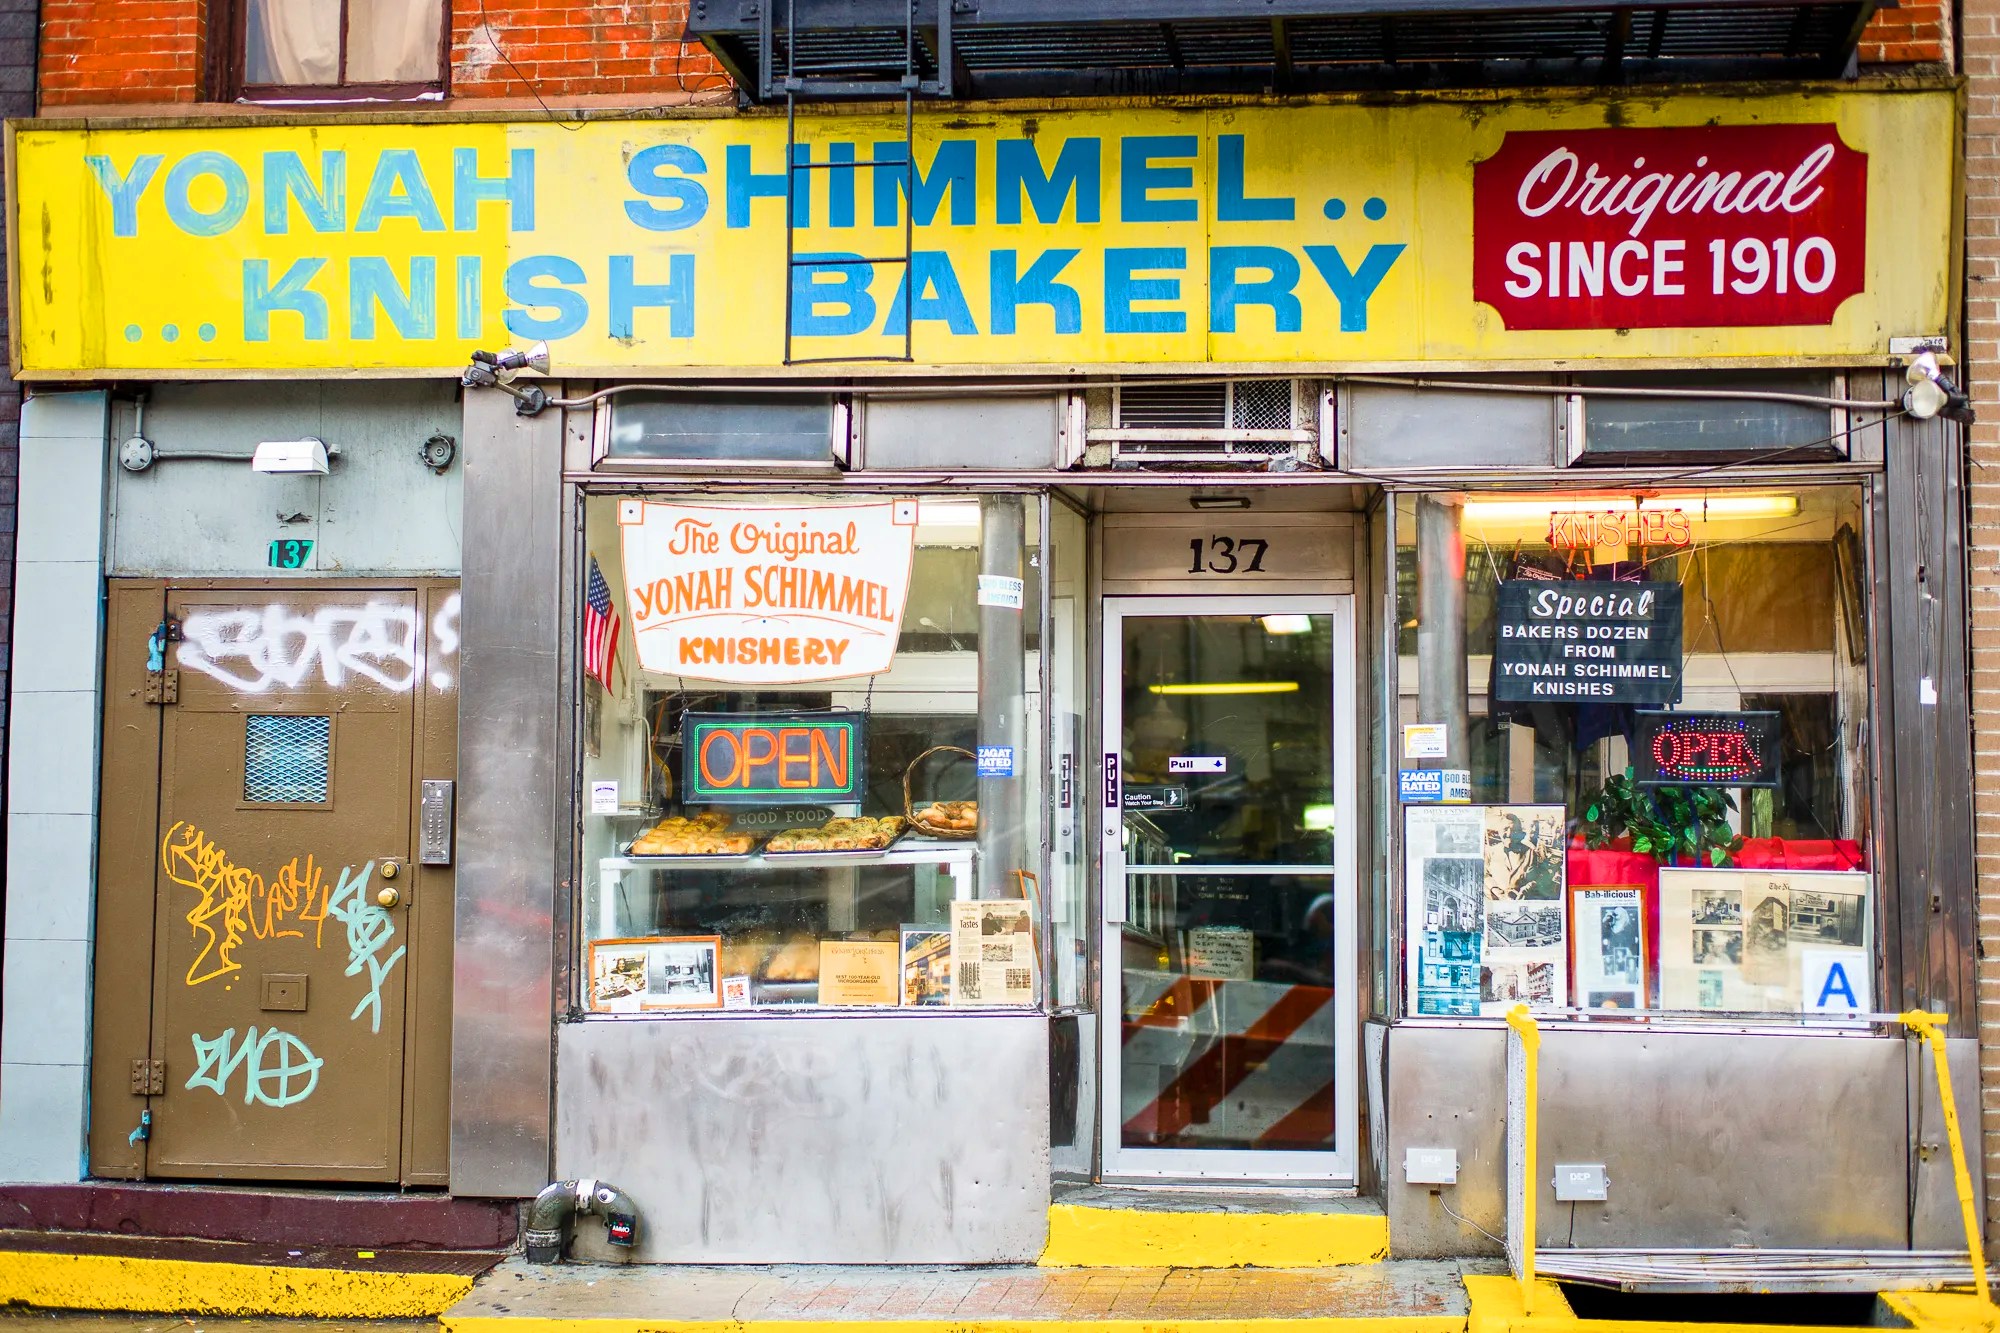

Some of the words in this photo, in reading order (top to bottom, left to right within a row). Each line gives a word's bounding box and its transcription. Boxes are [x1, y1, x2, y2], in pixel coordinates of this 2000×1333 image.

[85, 147, 535, 237] YONAH
[1517, 142, 1836, 238] Original
[1503, 240, 1686, 299] SINCE
[1708, 235, 1837, 295] 1910
[789, 243, 1408, 336] BAKERY
[668, 517, 719, 555] The
[730, 520, 860, 562] Original
[1550, 511, 1691, 550] KNISHES
[269, 539, 315, 569] 137
[1188, 534, 1269, 574] 137
[633, 567, 734, 622] YONAH
[743, 563, 895, 623] SCHIMMEL
[1531, 589, 1655, 620] Special
[1502, 625, 1579, 639] BAKERS
[1586, 626, 1649, 640] DOZEN
[678, 636, 850, 666] KNISHERY
[1564, 645, 1616, 658] FROM
[1503, 662, 1567, 677] YONAH
[1574, 664, 1672, 679] SCHIMMEL
[1532, 681, 1614, 696] KNISHES
[699, 727, 848, 789] OPEN
[978, 748, 1012, 758] ZAGAT
[978, 757, 1012, 767] RATED
[1170, 760, 1194, 769] Pull
[1652, 733, 1763, 767] OPEN
[1107, 757, 1116, 803] PULL
[1401, 772, 1441, 782] ZAGAT
[1401, 781, 1441, 791] RATED
[1444, 773, 1460, 784] GOD
[736, 811, 777, 825] GOOD
[785, 809, 827, 823] FOOD
[1584, 889, 1636, 899] Bab-ilicious!
[960, 919, 979, 929] Tastes
[1816, 962, 1858, 1008] A
